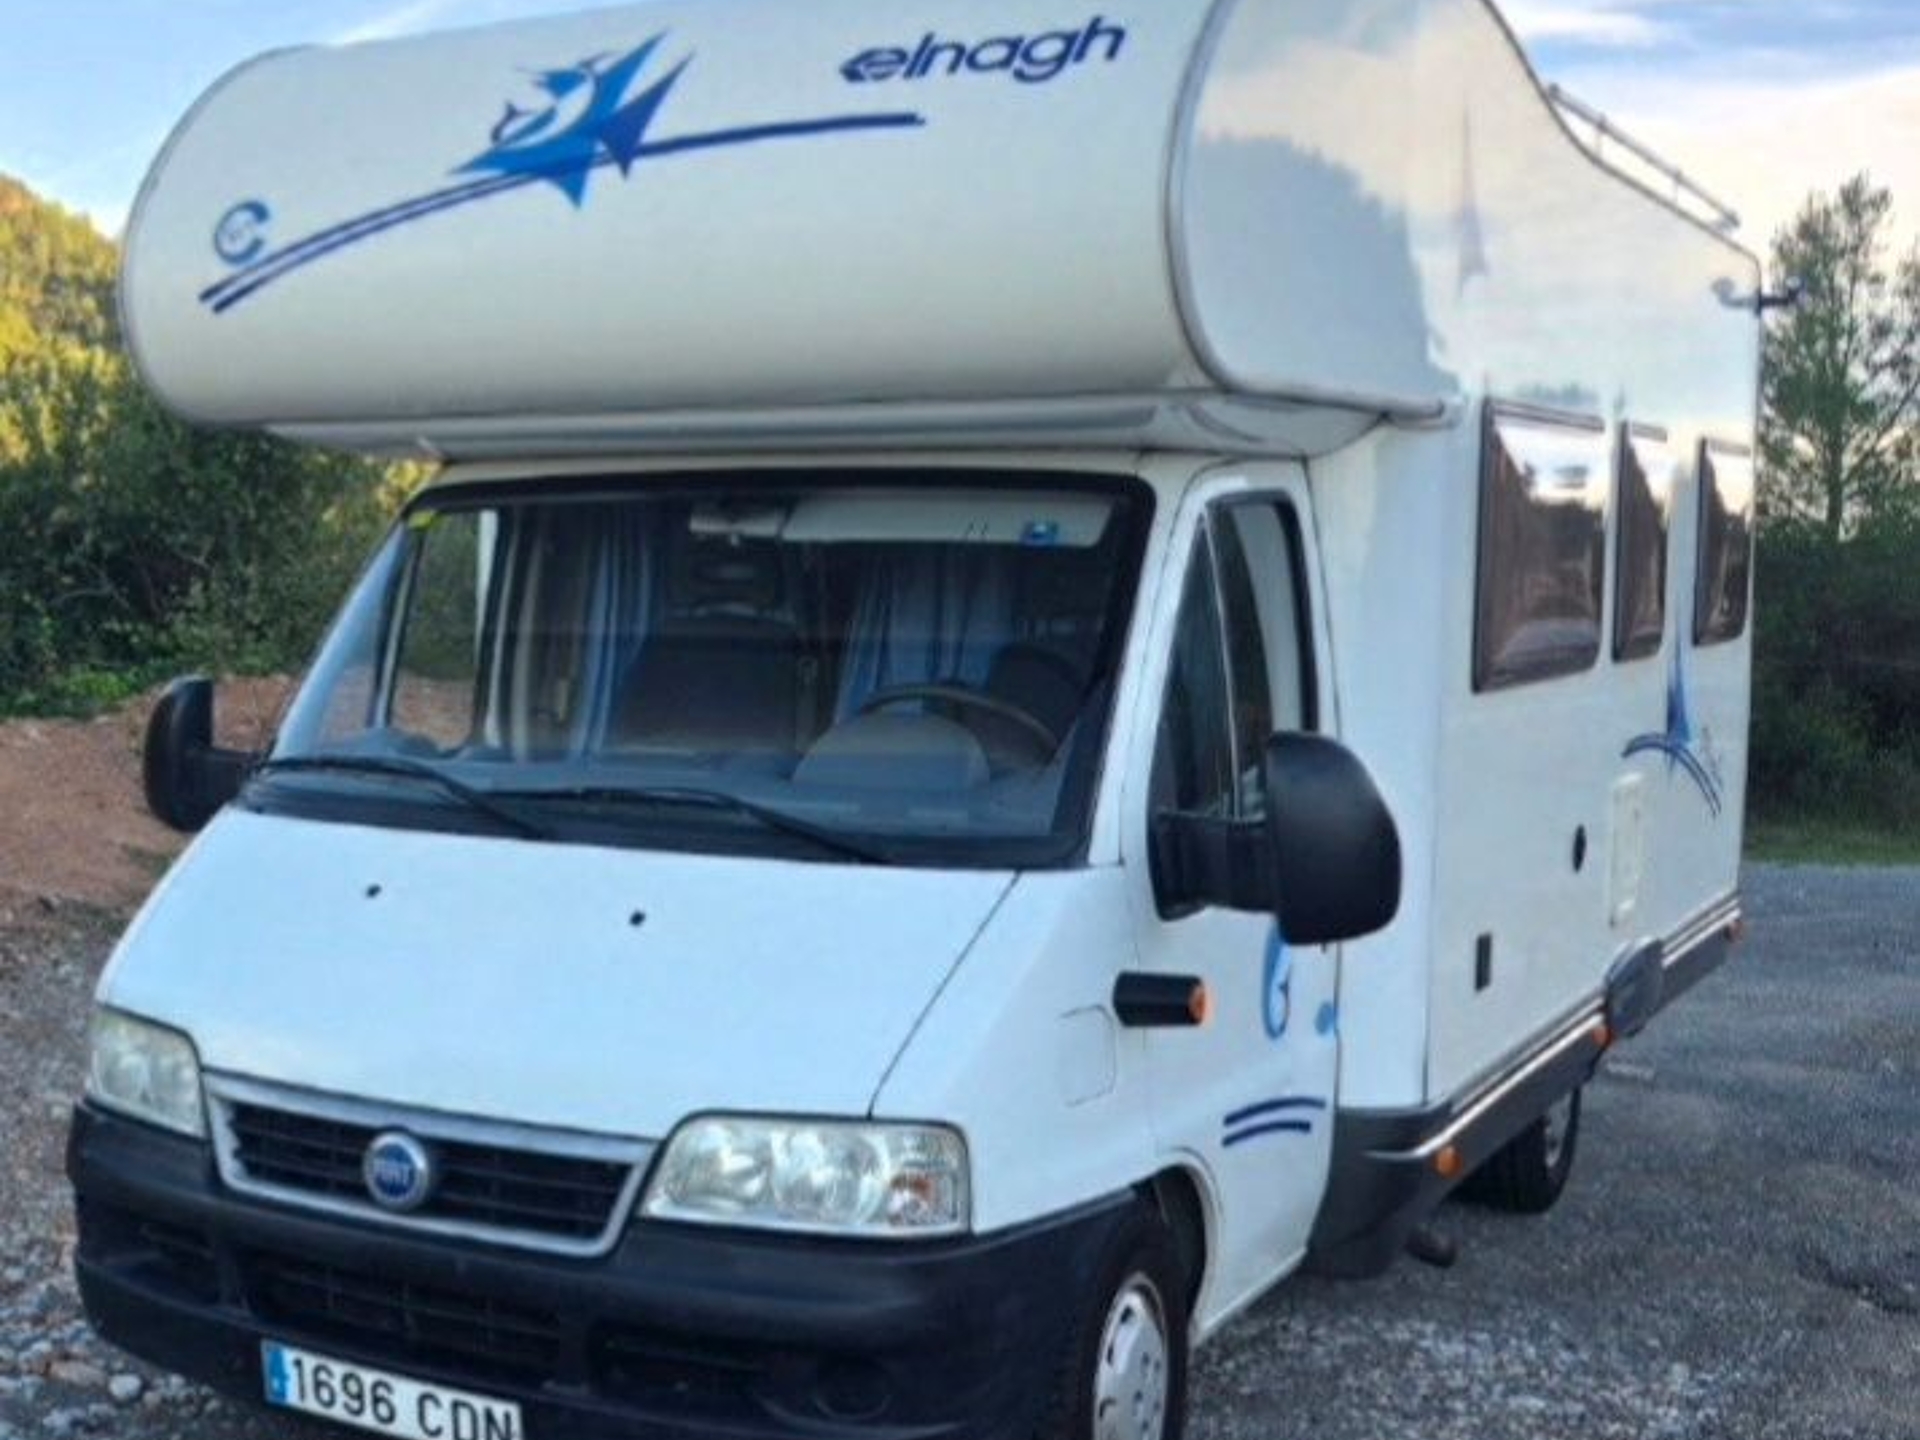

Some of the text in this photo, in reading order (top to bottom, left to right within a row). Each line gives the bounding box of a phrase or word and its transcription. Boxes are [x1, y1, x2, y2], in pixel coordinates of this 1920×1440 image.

[839, 15, 1126, 83] elnagh
[293, 1357, 513, 1440] 1696 CDN
